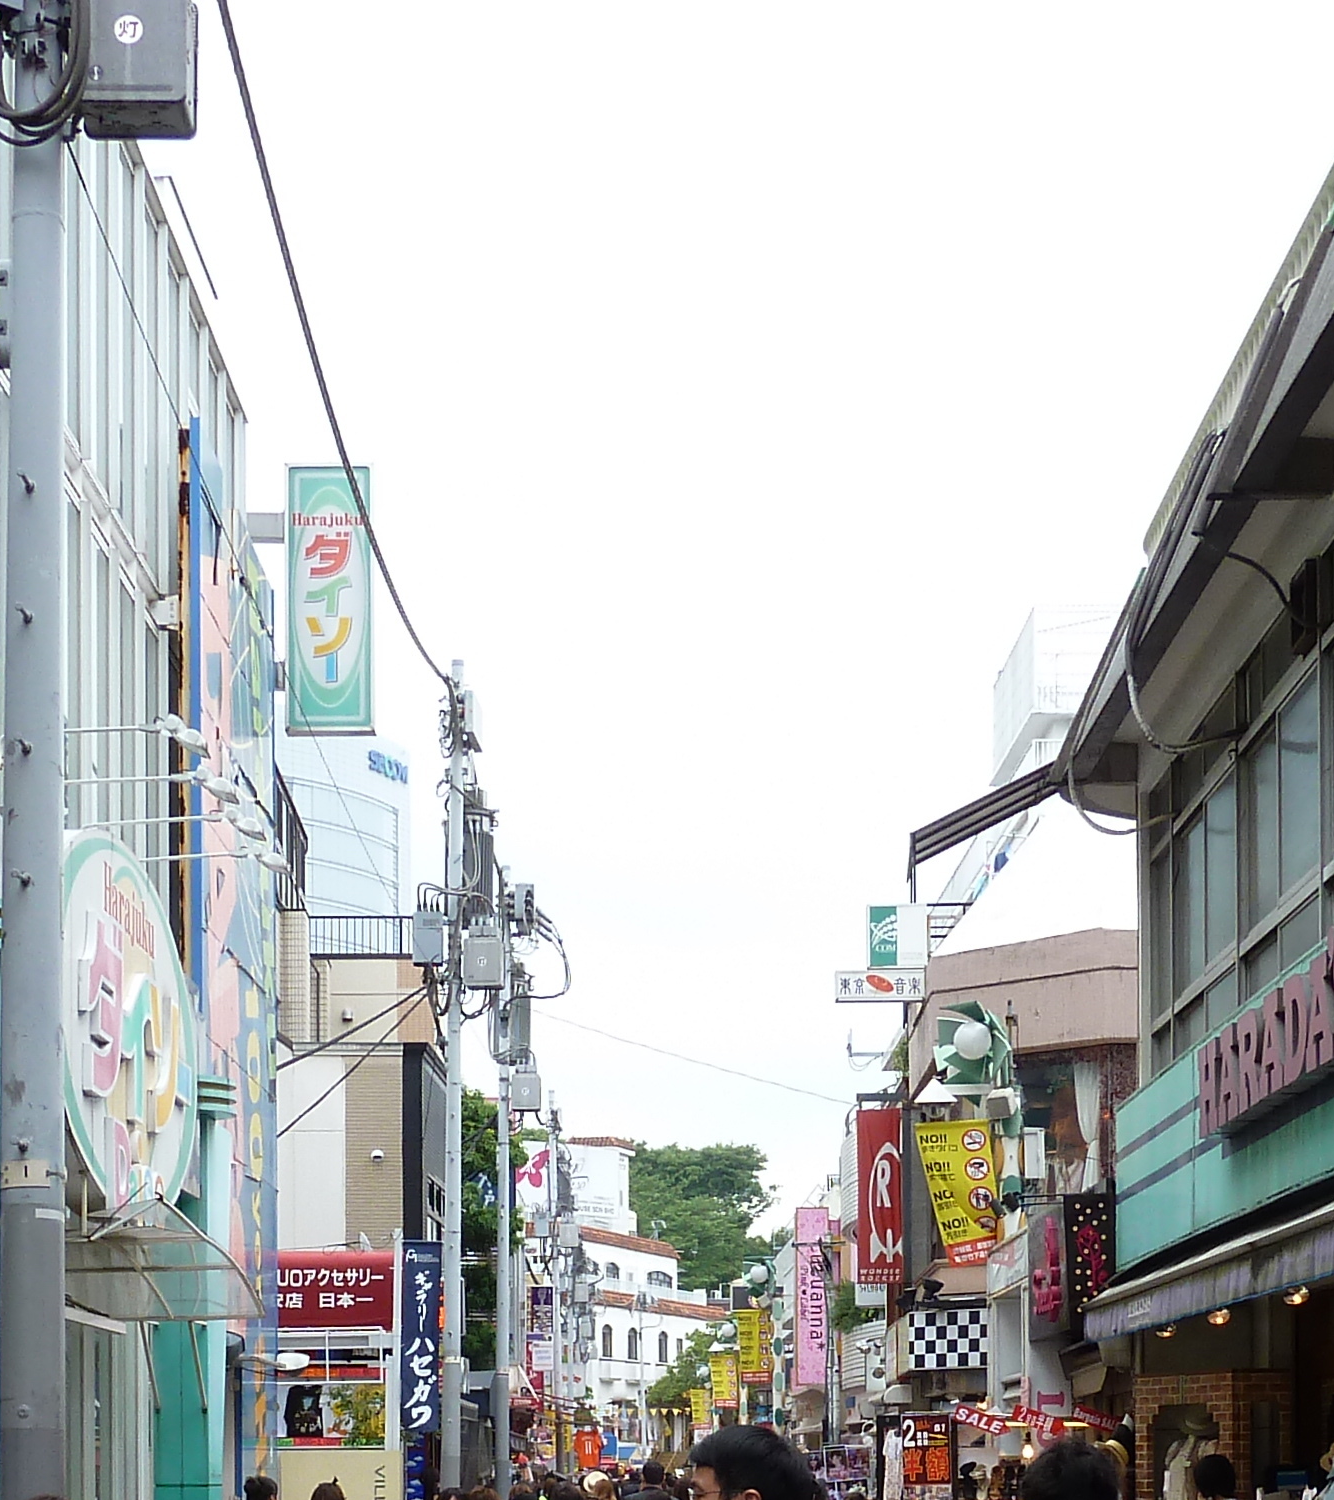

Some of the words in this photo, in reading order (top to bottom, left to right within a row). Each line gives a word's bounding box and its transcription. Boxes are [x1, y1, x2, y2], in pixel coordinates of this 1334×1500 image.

[292, 512, 367, 528] Harajuku
[304, 531, 353, 684] ダイソー
[103, 860, 156, 960] Harajuku
[79, 910, 192, 1136] ダイソー
[920, 1134, 947, 1145] NO!!
[925, 1162, 950, 1174] NO!!
[942, 1216, 970, 1231] NO!!
[319, 1292, 374, 1309] 日本一
[404, 1337, 438, 1430] ハセガワ
[956, 1408, 1003, 1434] SALE
[903, 1447, 950, 1481] 半額
